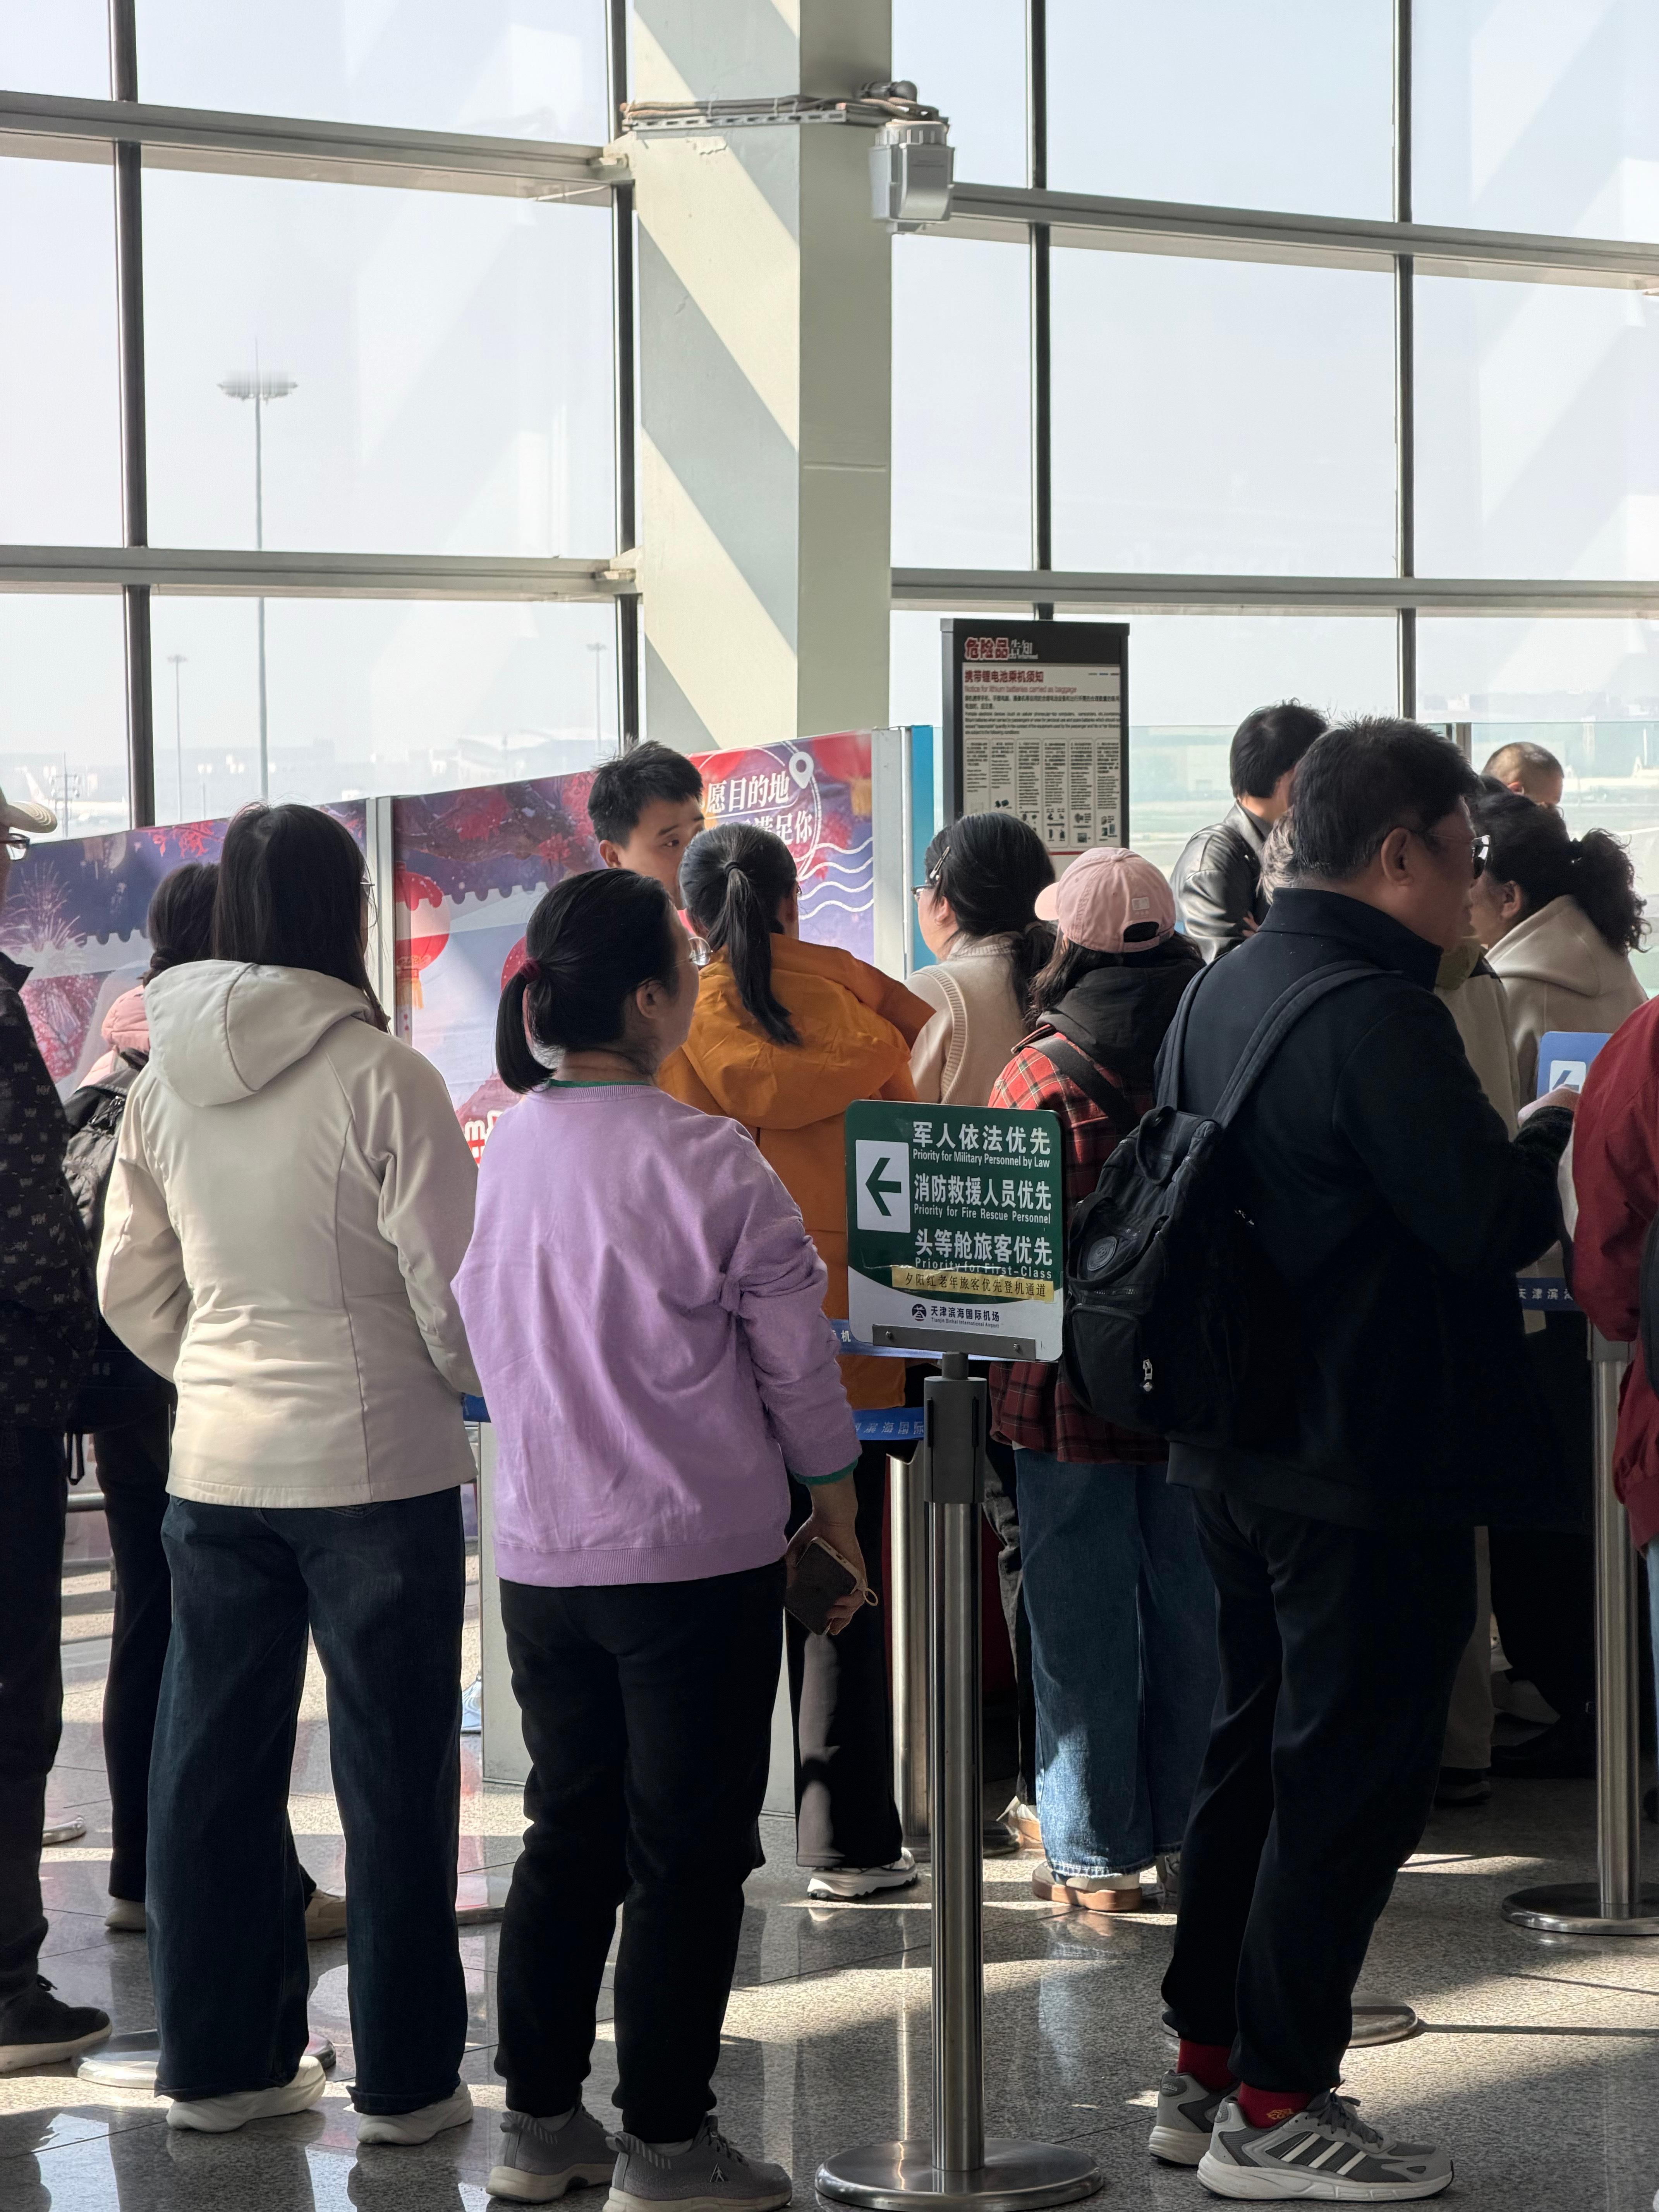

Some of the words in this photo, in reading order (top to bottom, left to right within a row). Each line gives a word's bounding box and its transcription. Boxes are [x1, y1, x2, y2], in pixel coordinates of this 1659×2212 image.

[701, 771, 790, 814] 愿目的地
[913, 1121, 1051, 1155] 军人依法优先
[913, 1148, 940, 1163] Priority
[941, 1150, 953, 1161] for
[954, 1151, 982, 1166] Military
[984, 1153, 1021, 1166] Personnel
[1023, 1156, 1032, 1169] by
[1034, 1156, 1050, 1168] Law
[914, 1173, 1052, 1210] 消防救援人员优先
[914, 1203, 943, 1218] Priority
[947, 1206, 958, 1217] for
[962, 1207, 977, 1218] Fire
[980, 1208, 1008, 1221] Rescue
[1012, 1211, 1051, 1224] Personnel
[915, 1228, 1053, 1266] 头等舱旅客优先
[915, 1257, 960, 1272] Priority
[964, 1261, 980, 1273] for
[985, 1263, 1052, 1279] First-Class
[905, 1273, 1046, 1297] 夕阳红老年旅客优先登机通道
[931, 1306, 1000, 1322] 天津滨海国际机场
